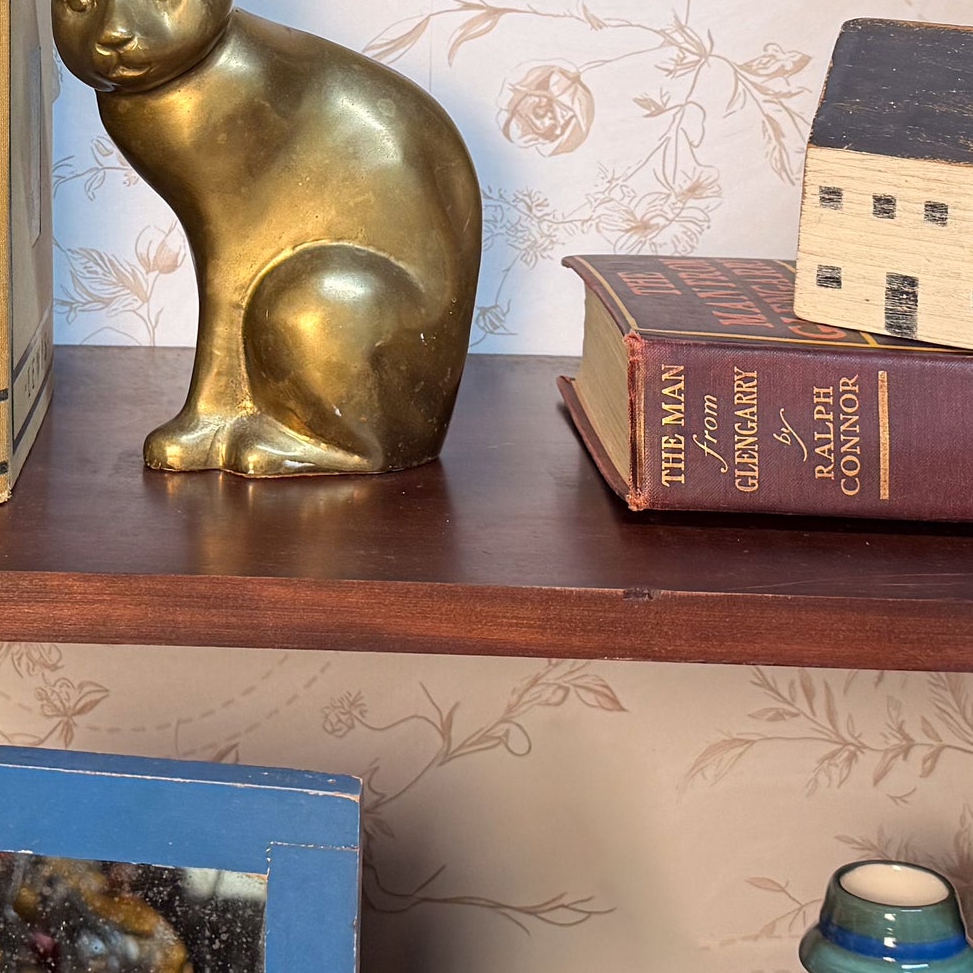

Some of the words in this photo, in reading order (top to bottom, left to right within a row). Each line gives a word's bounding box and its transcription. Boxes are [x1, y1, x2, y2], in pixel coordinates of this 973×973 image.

[617, 271, 682, 296] THE
[658, 258, 737, 288] FROM
[692, 286, 775, 329] MAN
[661, 364, 685, 427] MAN
[692, 395, 728, 473] from
[734, 366, 759, 493] GLENGARRY
[773, 408, 808, 462] by
[813, 386, 835, 480] RALPH
[840, 374, 861, 497] CONNOR
[661, 434, 685, 488] THE
